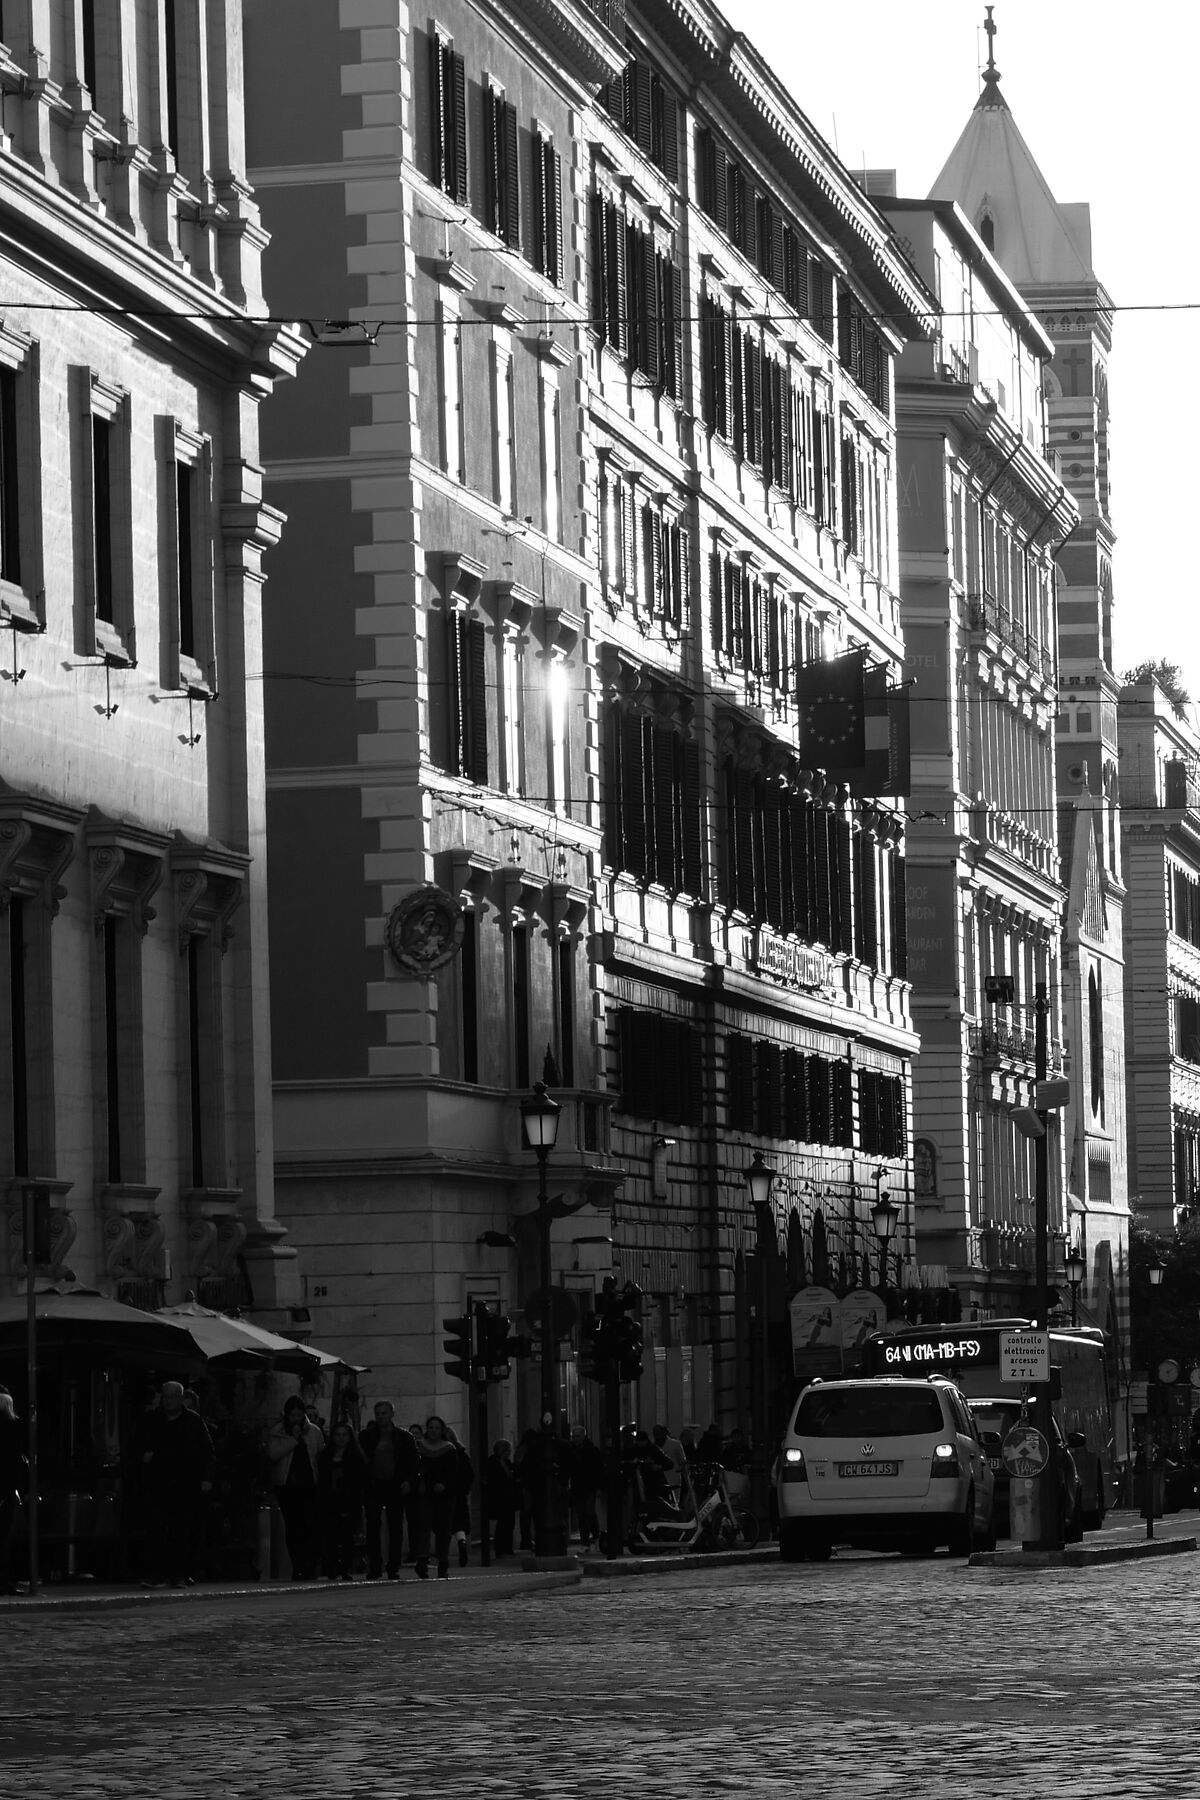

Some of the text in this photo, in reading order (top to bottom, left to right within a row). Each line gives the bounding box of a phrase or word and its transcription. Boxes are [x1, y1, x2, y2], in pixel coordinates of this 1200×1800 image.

[1007, 1336, 1042, 1344] controllo
[1004, 1346, 1045, 1354] elettronico
[885, 1346, 901, 1363] 64
